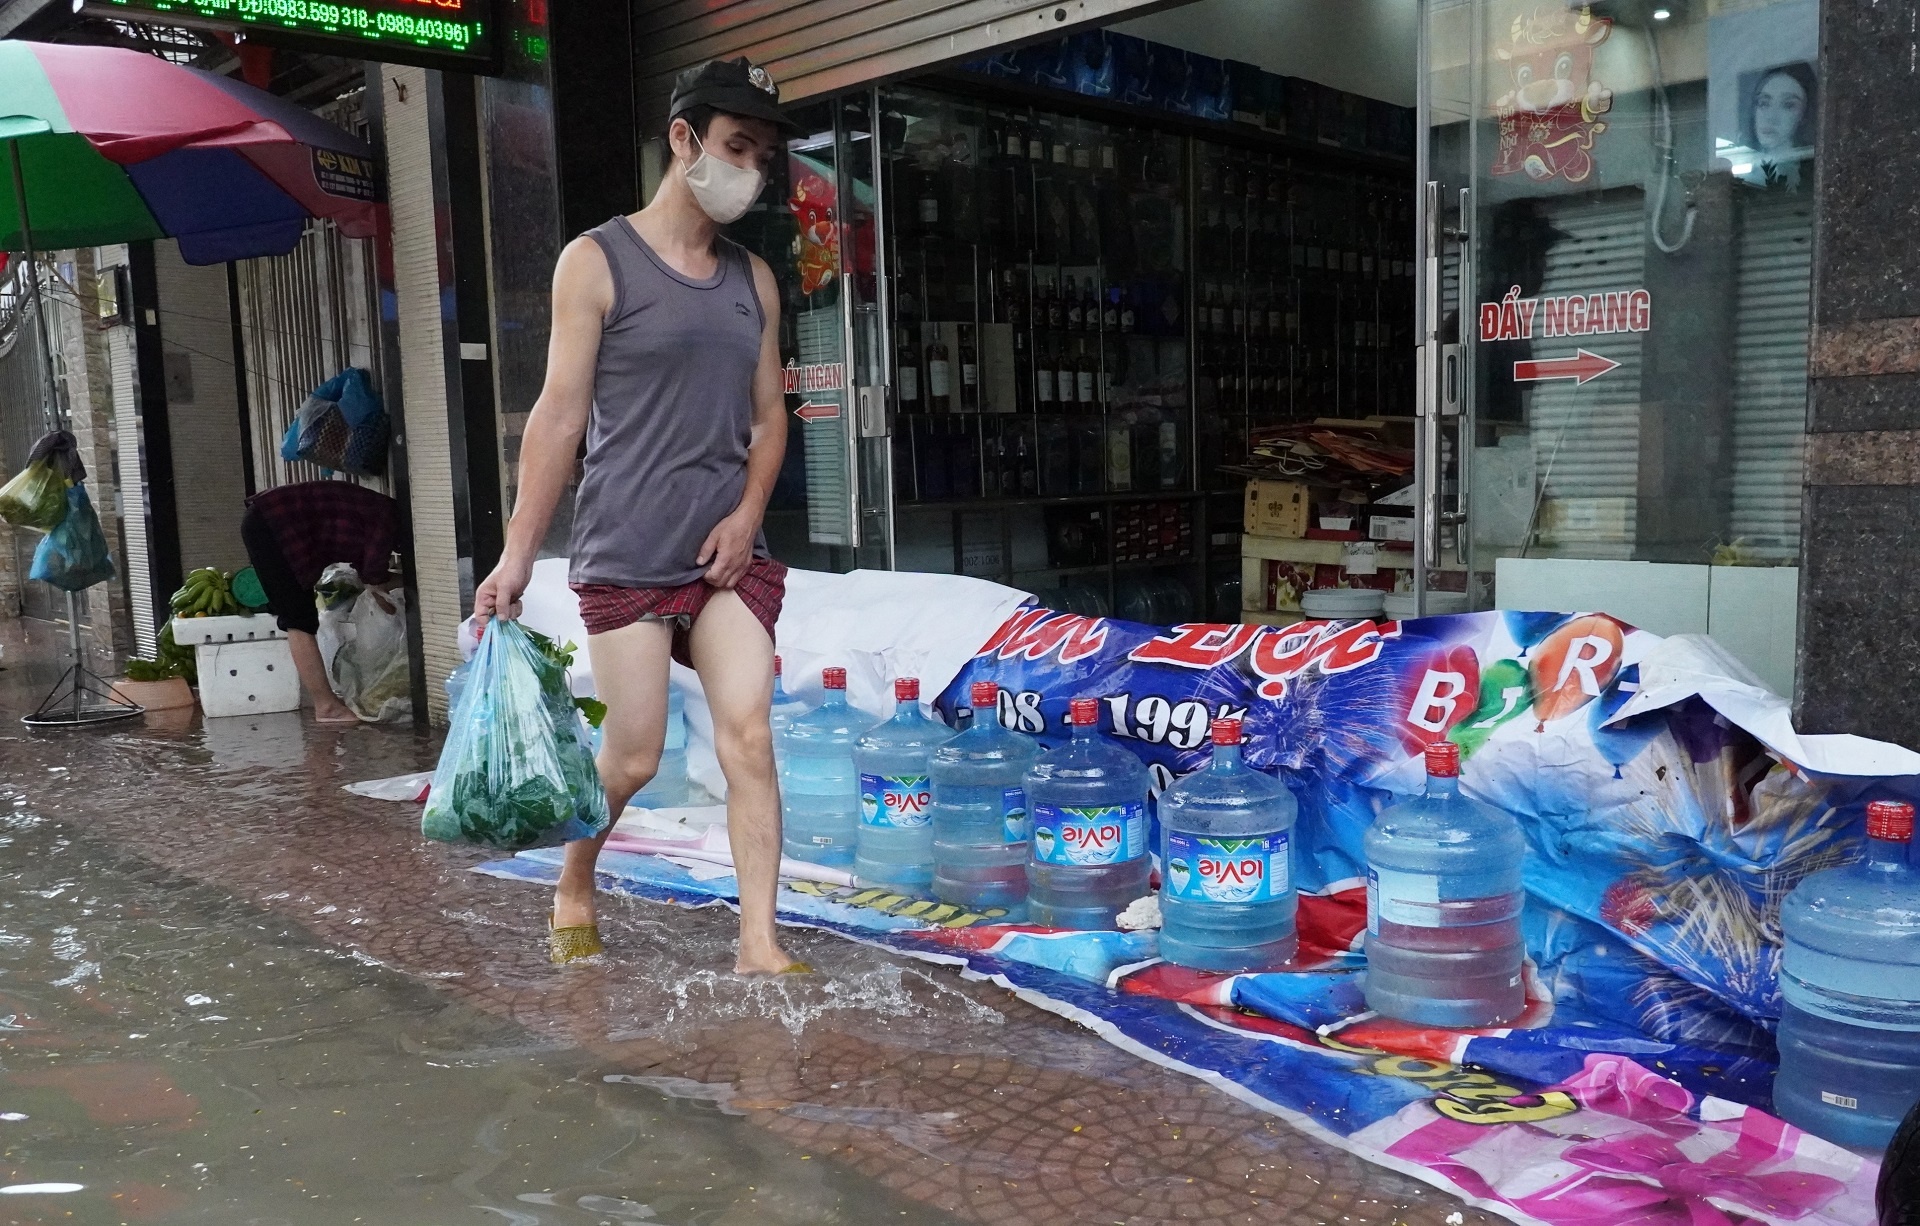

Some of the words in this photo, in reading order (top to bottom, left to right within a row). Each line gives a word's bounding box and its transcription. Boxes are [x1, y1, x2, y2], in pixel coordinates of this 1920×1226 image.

[1480, 284, 1538, 342] ĐẨY
[1543, 288, 1651, 338] NGANG
[883, 792, 931, 813] aVie
[1061, 825, 1121, 849] laVie
[1198, 859, 1263, 884] laVie
